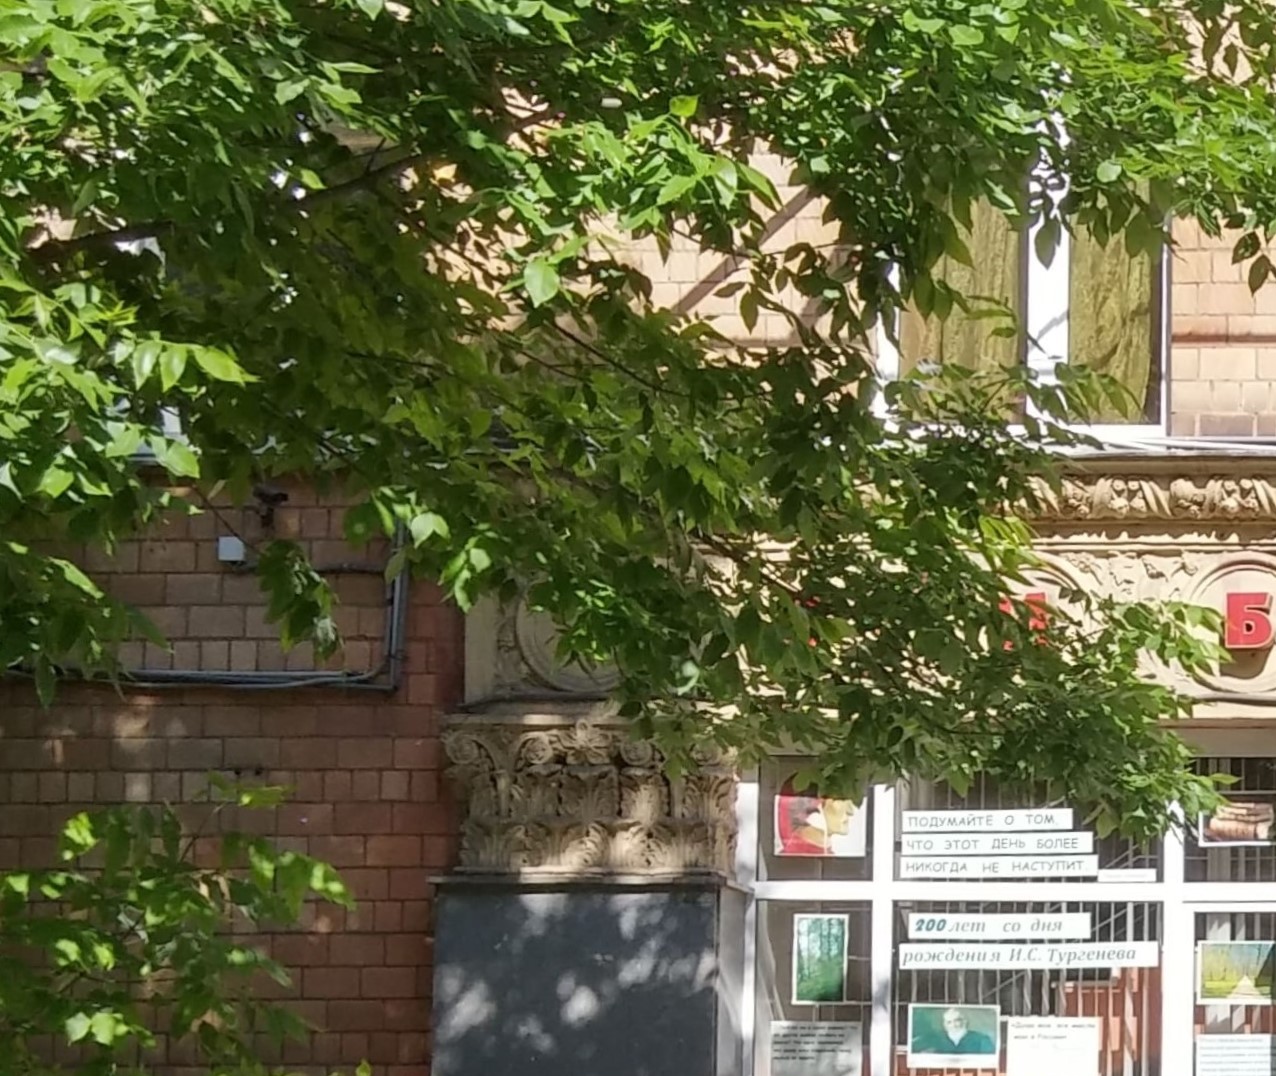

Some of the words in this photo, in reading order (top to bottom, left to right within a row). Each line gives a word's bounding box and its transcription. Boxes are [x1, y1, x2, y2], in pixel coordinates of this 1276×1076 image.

[908, 813, 994, 828] ПОДУМАЙТЕ
[1004, 814, 1015, 826] О
[906, 839, 934, 851] ЧТО
[944, 839, 980, 851] ЭТОТ
[991, 838, 1026, 850] ДЕНЬ
[1036, 837, 1079, 849] БОЛЕЕ
[905, 861, 968, 873] НИКОГДА
[982, 861, 999, 873] НЕ
[914, 918, 947, 932] 200
[948, 920, 986, 933] лет
[1002, 921, 1021, 933] со
[1030, 918, 1063, 932] дня
[902, 947, 1001, 967] рождения
[1009, 946, 1042, 962] И.С.
[1047, 947, 1137, 966] Тургенева
